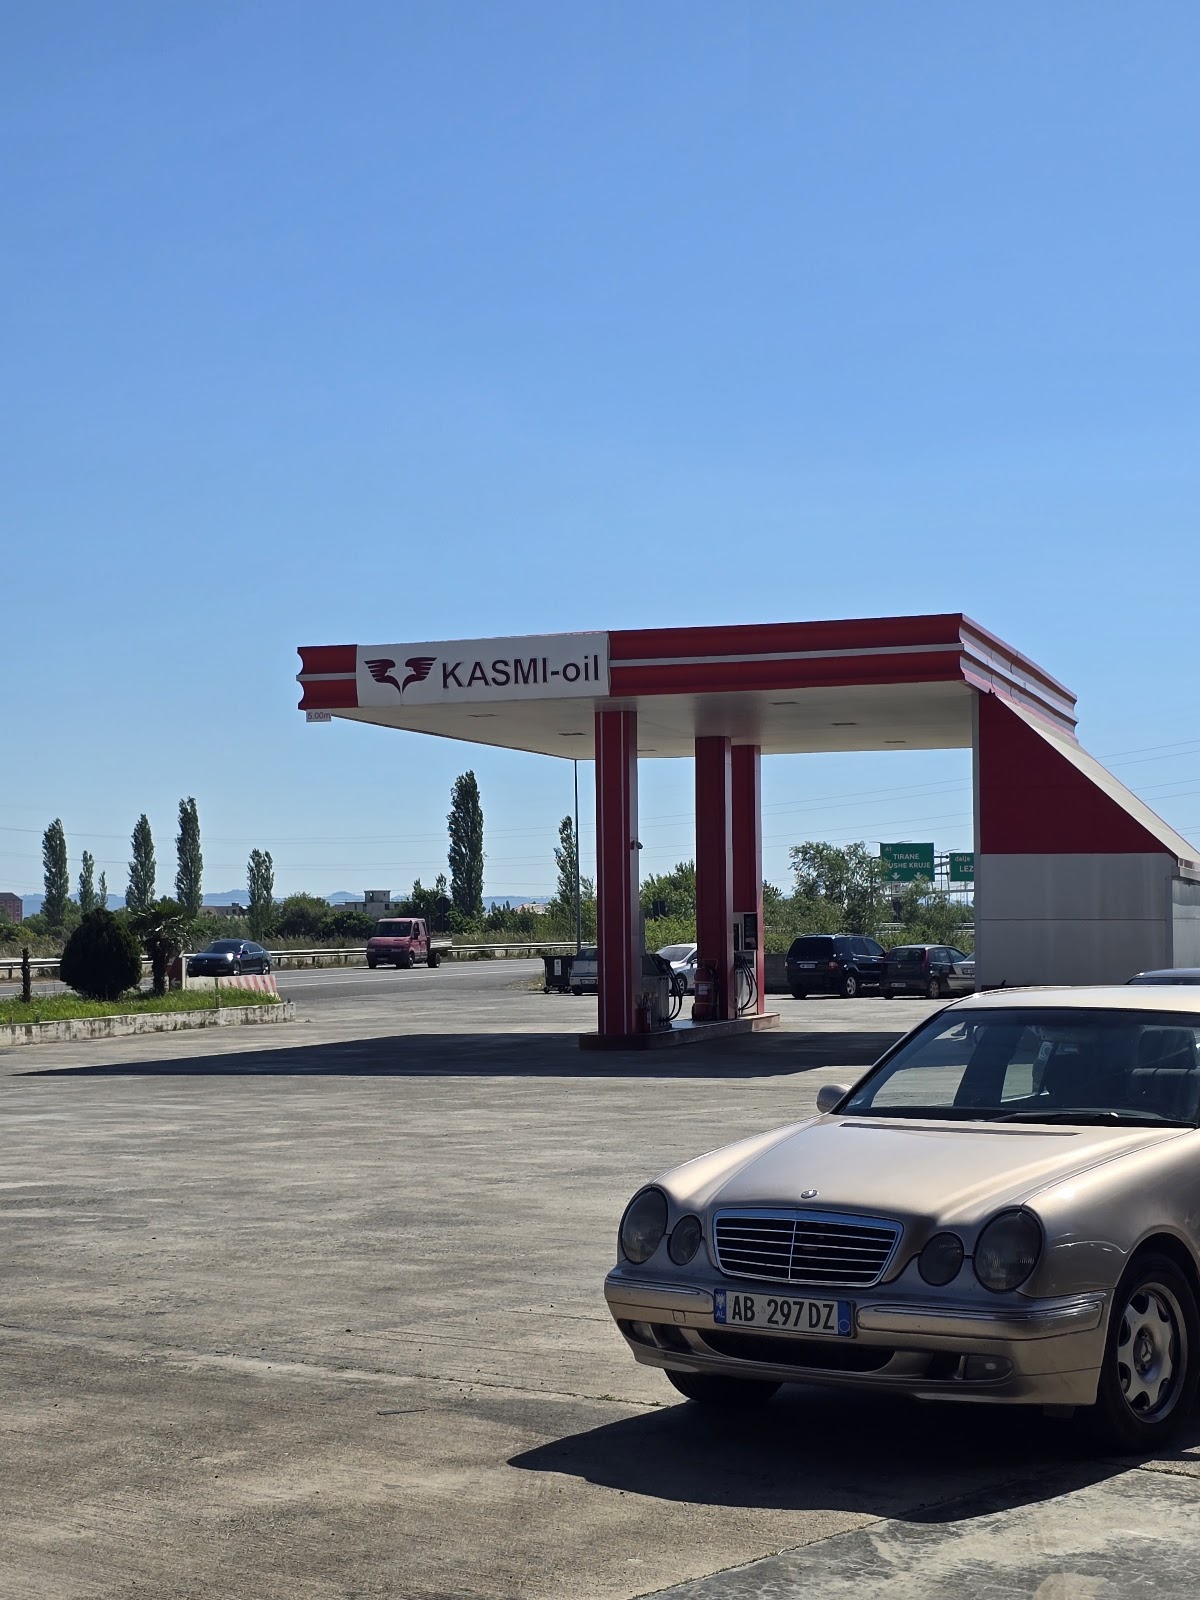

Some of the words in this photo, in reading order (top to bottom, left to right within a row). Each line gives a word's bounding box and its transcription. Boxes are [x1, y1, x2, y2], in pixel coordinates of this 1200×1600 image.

[442, 654, 600, 689] KASMI-oil
[308, 712, 331, 720] 5.00m
[716, 1310, 726, 1318] AL
[731, 1295, 756, 1322] AB
[767, 1299, 805, 1327] 297
[808, 1302, 835, 1330] DZ
